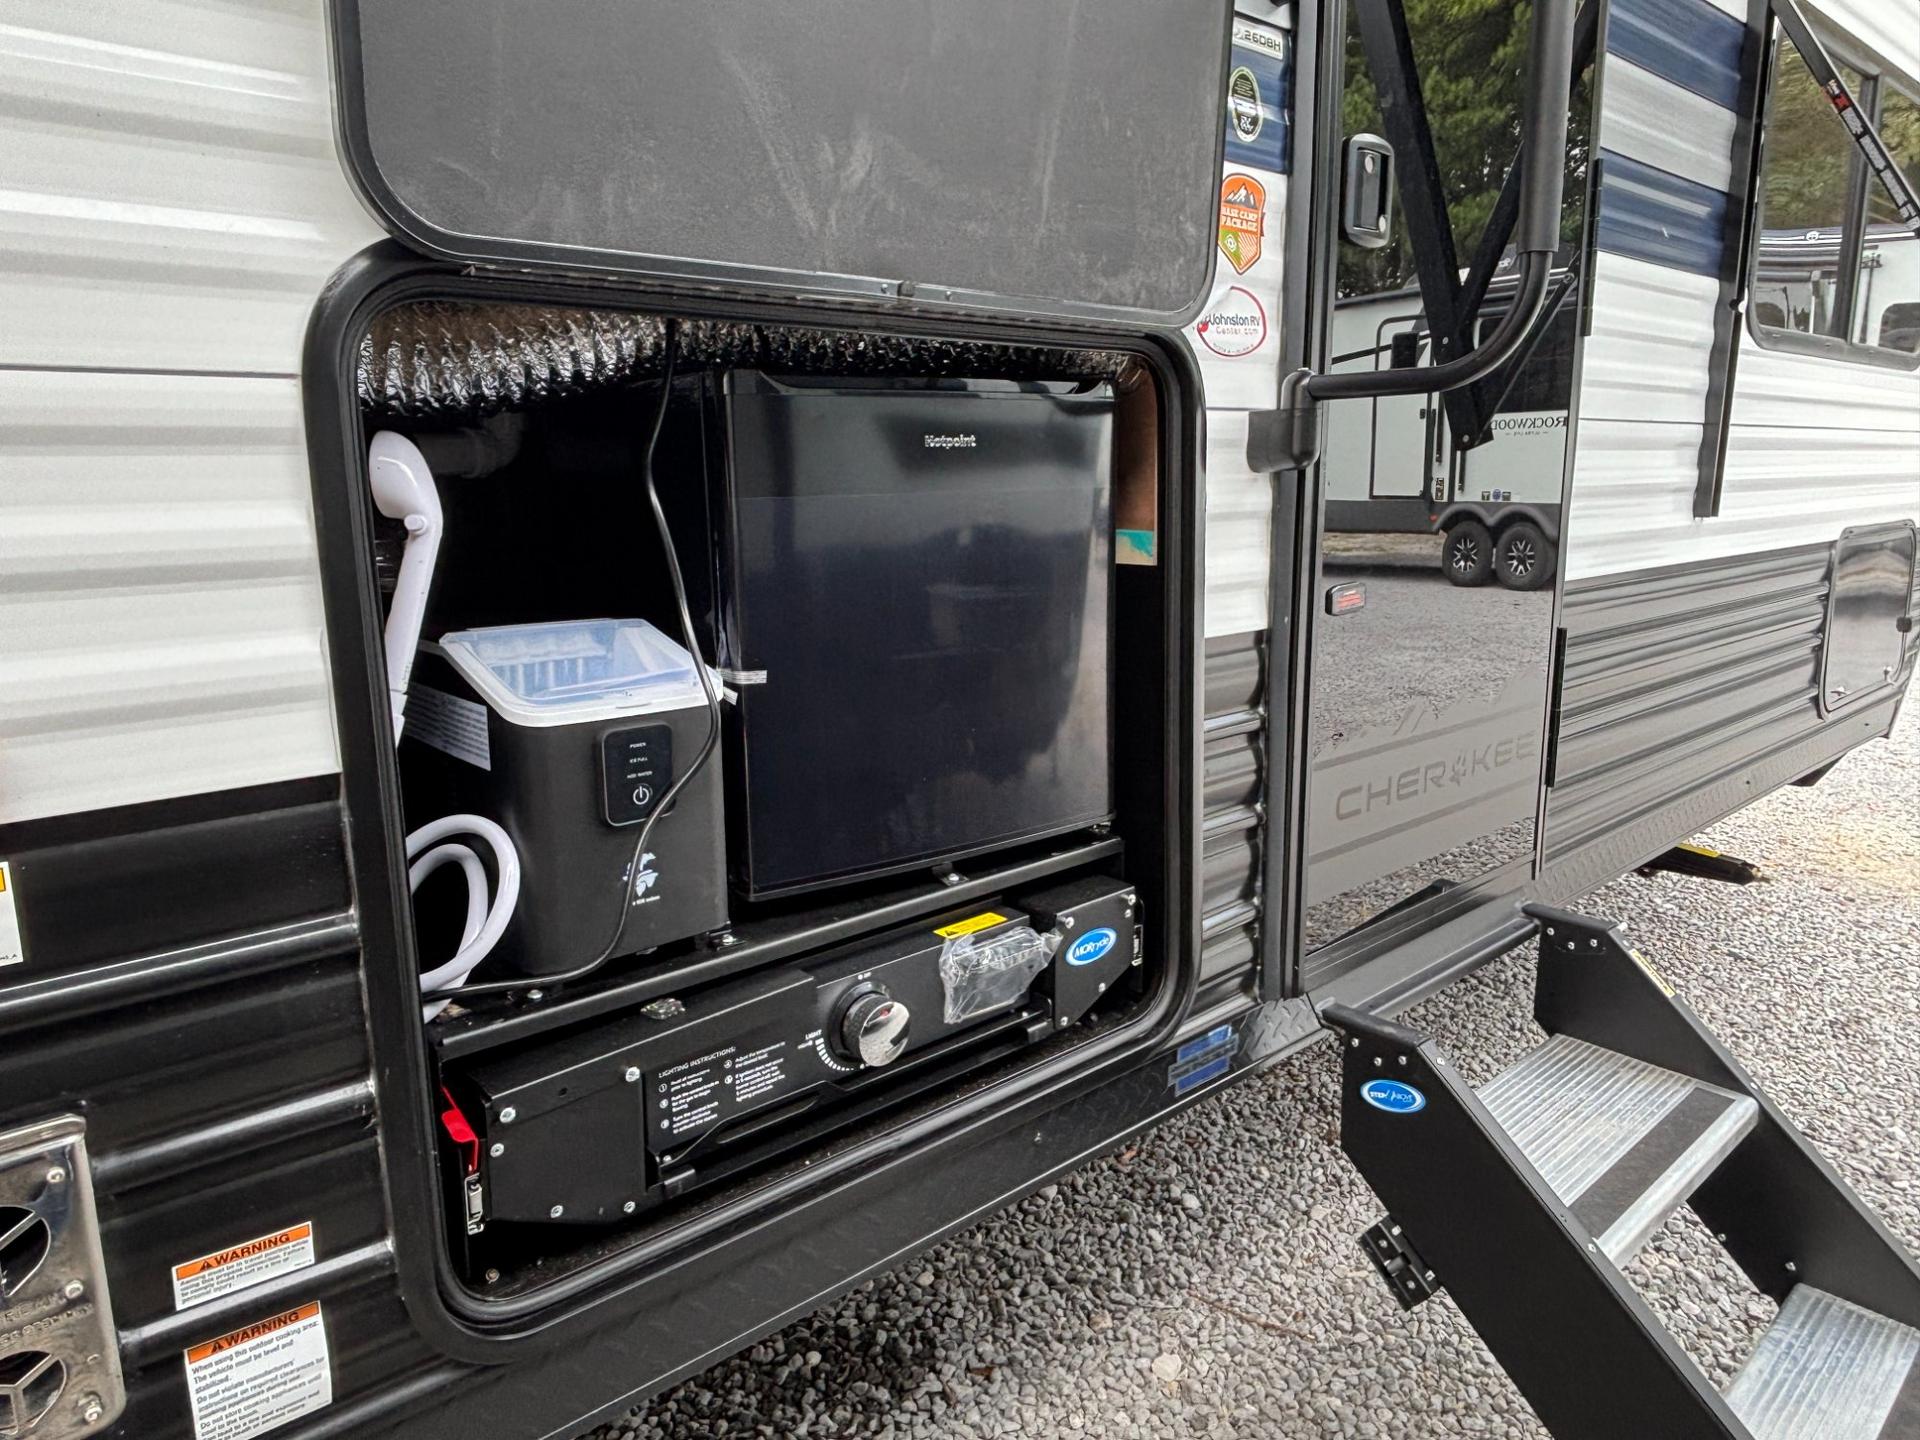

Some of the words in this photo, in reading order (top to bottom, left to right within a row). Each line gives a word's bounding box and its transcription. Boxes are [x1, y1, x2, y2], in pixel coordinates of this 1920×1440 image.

[1221, 215, 1258, 232] PACKAGE
[1250, 315, 1260, 326] RV
[658, 1062, 689, 1078] LIGHTING
[215, 1233, 290, 1265] WARNING
[225, 1311, 300, 1347] WARNING
[193, 1374, 207, 1384] The
[196, 1396, 207, 1405] Do
[200, 1421, 211, 1430] Do
